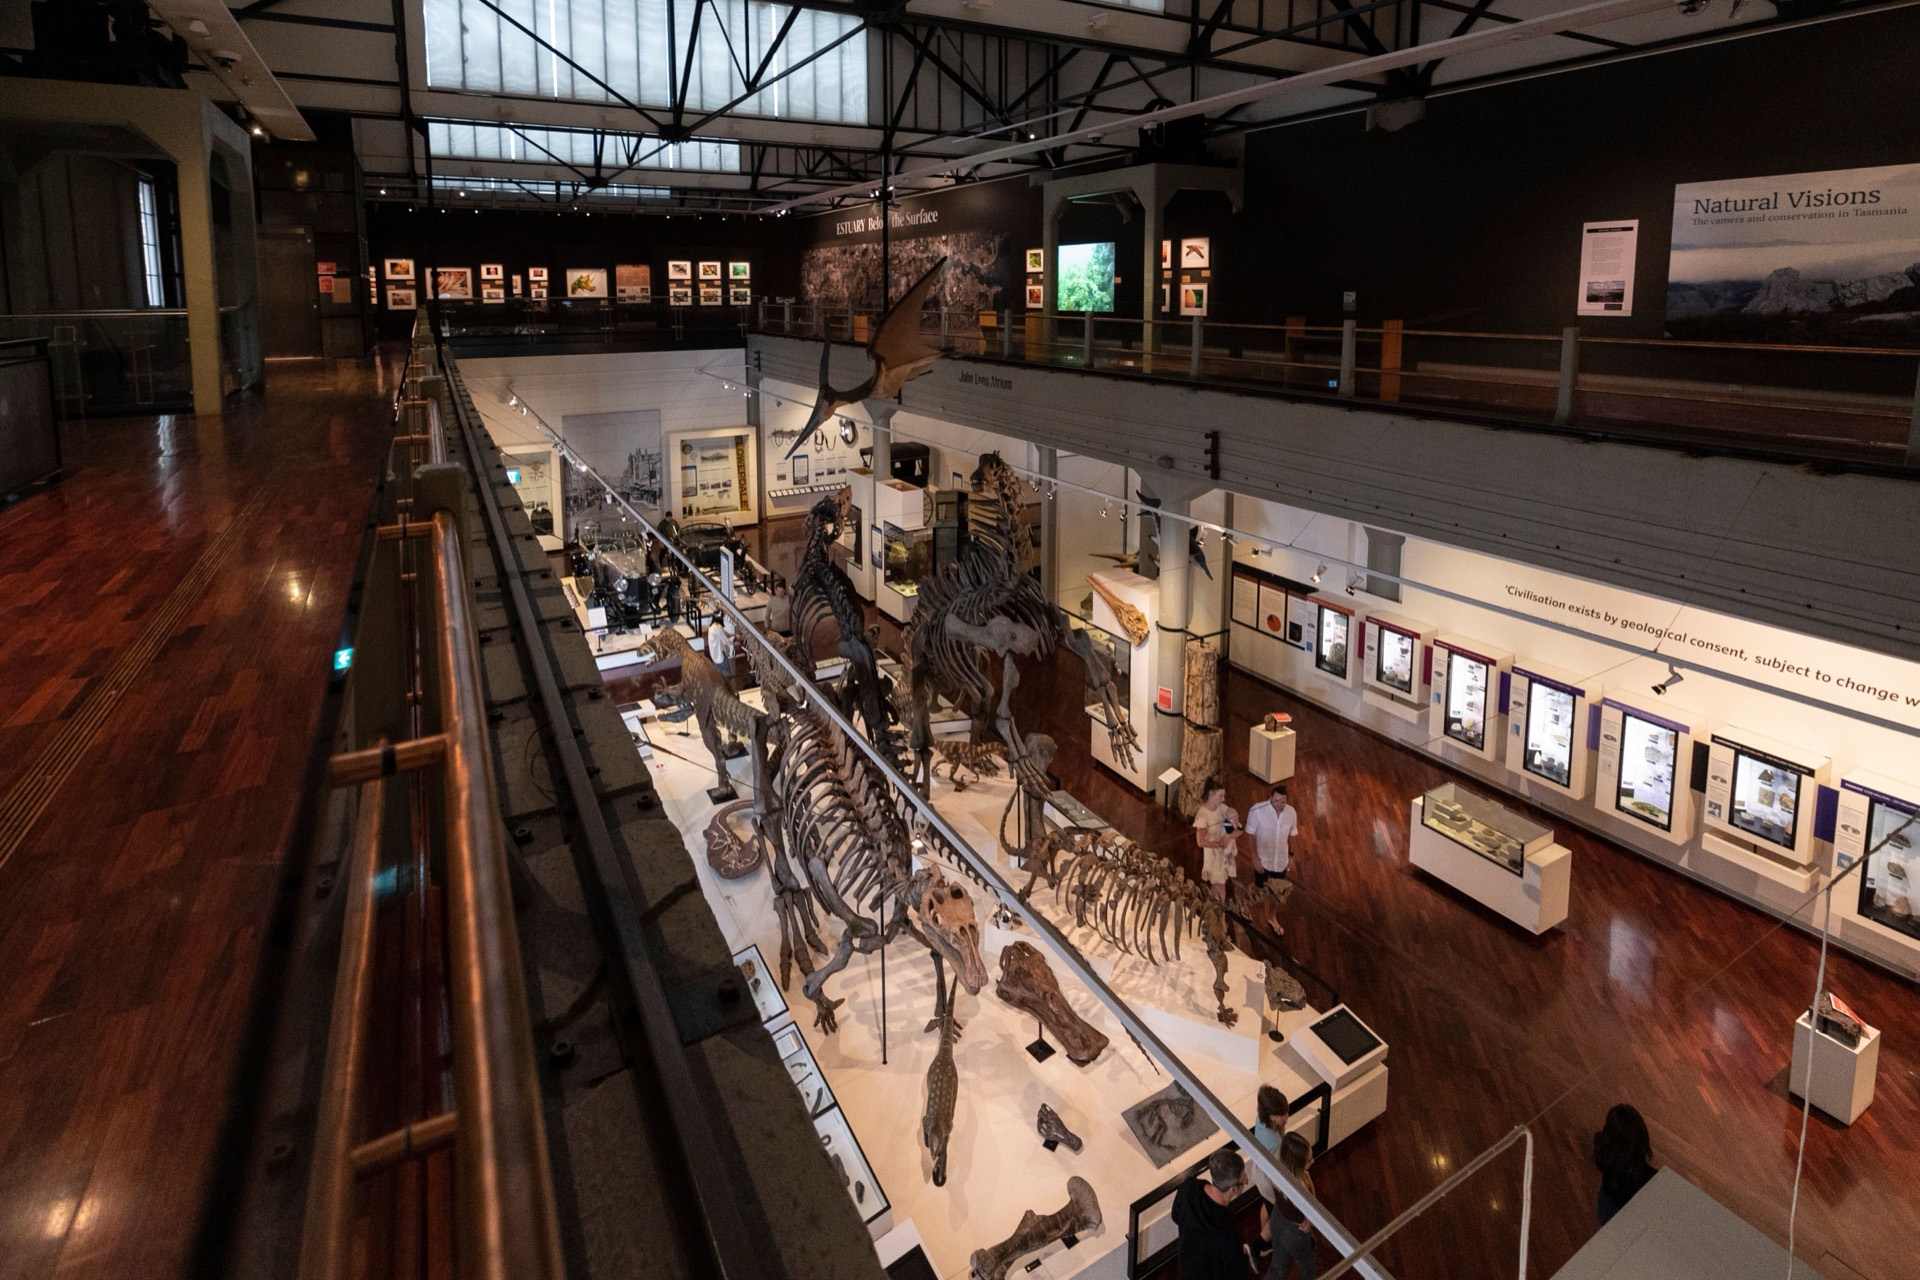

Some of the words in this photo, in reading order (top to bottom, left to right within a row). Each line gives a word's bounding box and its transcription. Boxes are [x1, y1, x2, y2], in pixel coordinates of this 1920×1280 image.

[1693, 191, 1779, 215] Natural
[1787, 188, 1881, 208] Visions
[836, 218, 866, 235] ESTUARY
[868, 215, 884, 231] Belo
[891, 213, 904, 228] the
[905, 208, 939, 226] Surface
[1692, 217, 1708, 226] The
[1710, 216, 1745, 225] camera
[1747, 213, 1766, 223] and
[1768, 210, 1835, 222] conservation
[1838, 209, 1849, 218] in
[1853, 206, 1908, 217] Tasmania
[959, 371, 974, 384] John
[1568, 603, 1601, 620] exists
[1603, 611, 1619, 626] by
[1620, 619, 1687, 643] geological
[1689, 637, 1748, 662] consent,
[1754, 655, 1811, 678] subject
[1815, 670, 1832, 684] to
[1836, 677, 1899, 702] change
